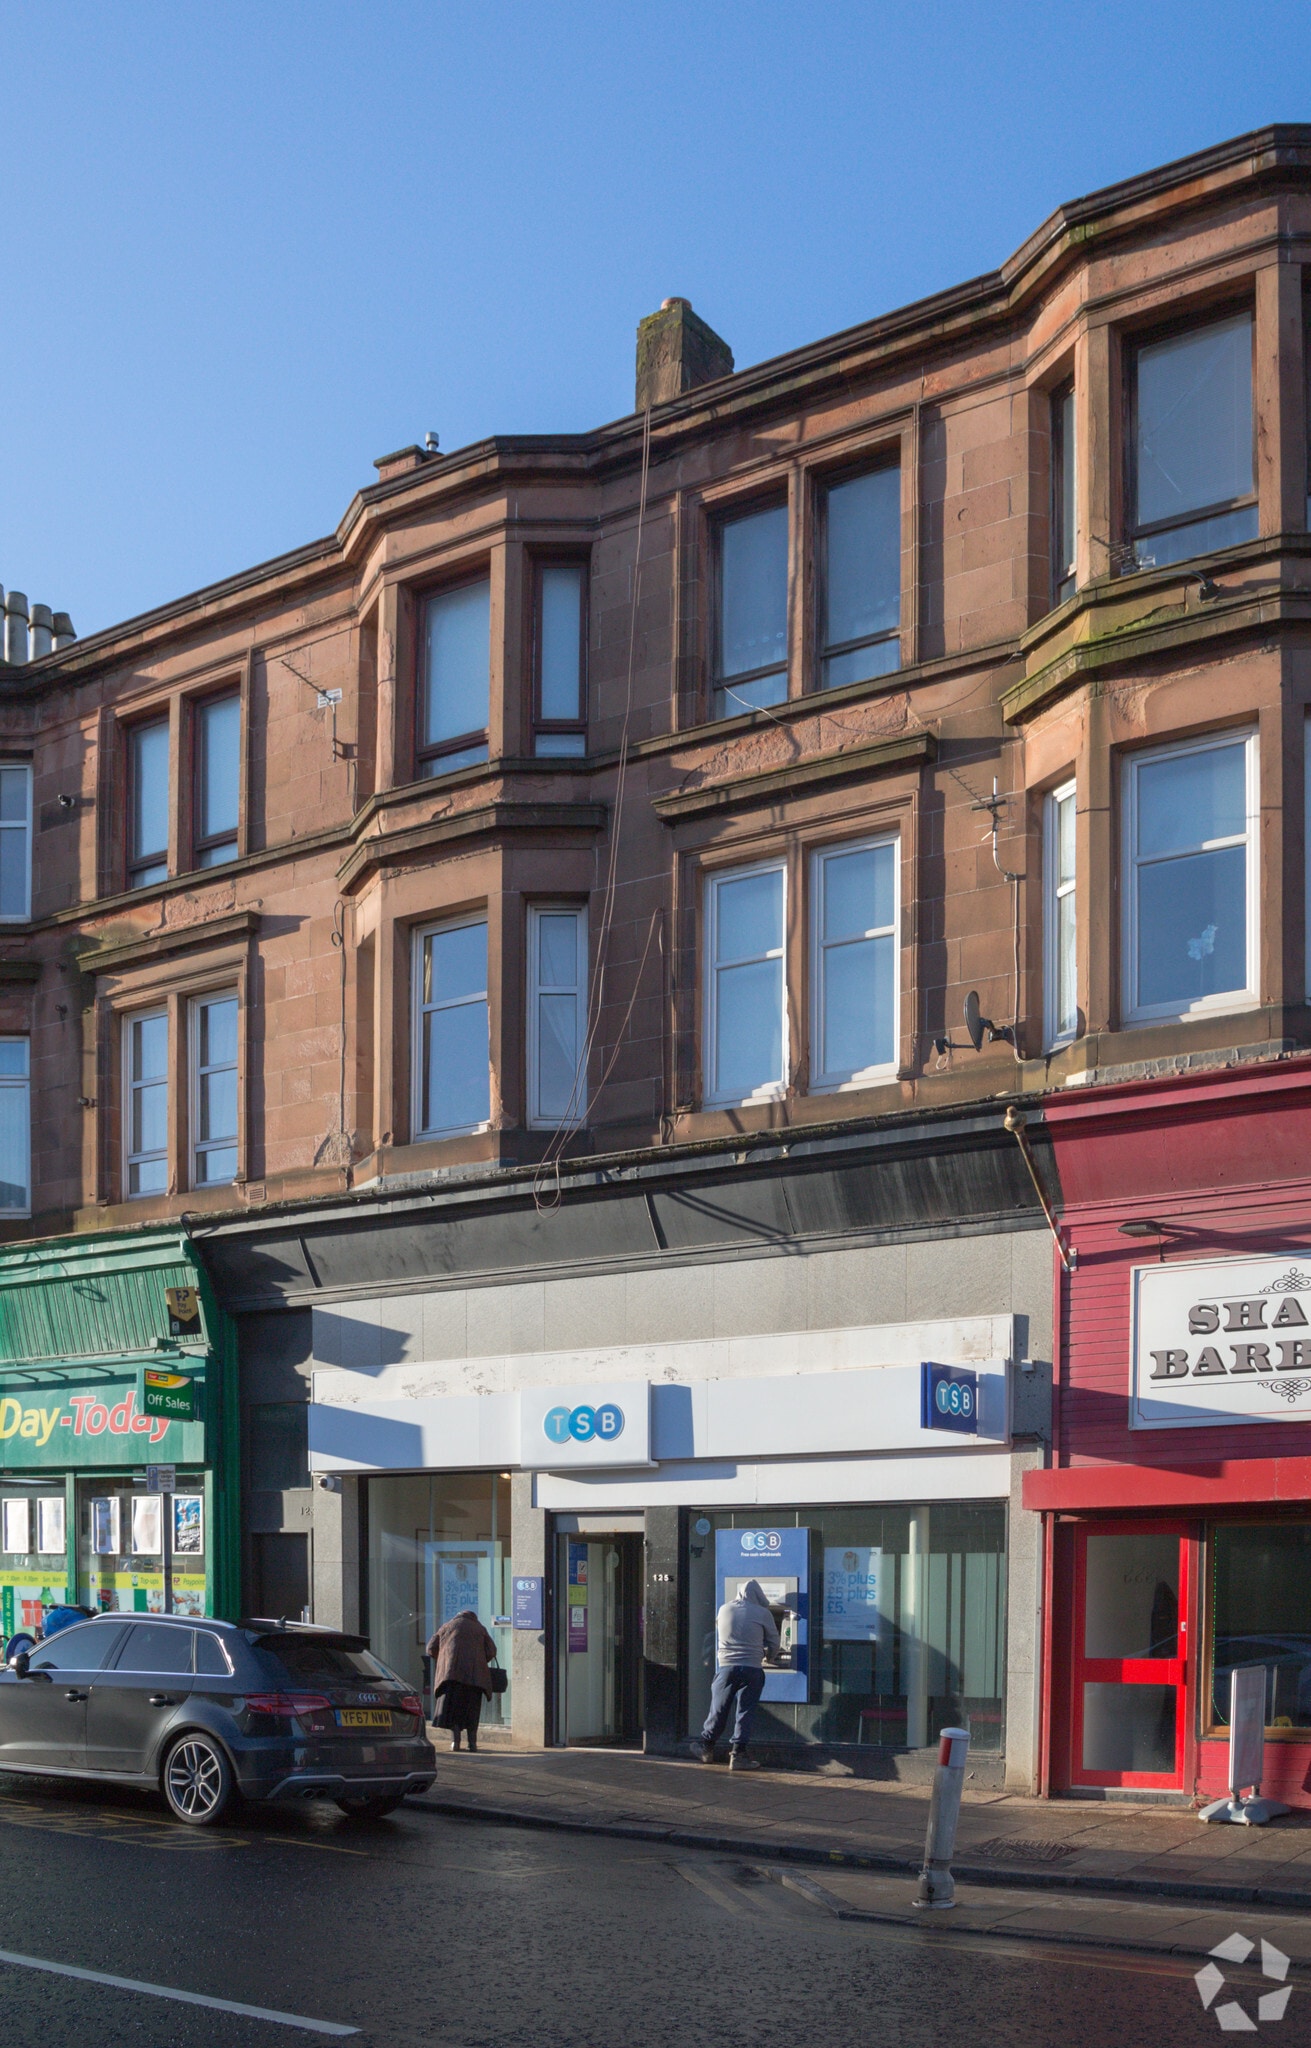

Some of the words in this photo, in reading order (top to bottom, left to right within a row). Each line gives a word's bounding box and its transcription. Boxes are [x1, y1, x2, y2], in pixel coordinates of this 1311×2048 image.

[1188, 1297, 1309, 1335] SHA
[1150, 1339, 1311, 1380] BARB
[147, 1393, 163, 1406] Off
[165, 1396, 191, 1410] Sales
[939, 1387, 971, 1411] TSB
[550, 1410, 618, 1436] TSB
[744, 1535, 778, 1547] TSB
[828, 1571, 846, 1584] 3%
[848, 1571, 876, 1587] plus
[827, 1587, 843, 1600] £5
[848, 1586, 876, 1602] plus
[827, 1601, 846, 1614] £5.
[342, 1711, 368, 1724] YF67
[371, 1711, 391, 1724] NWM
